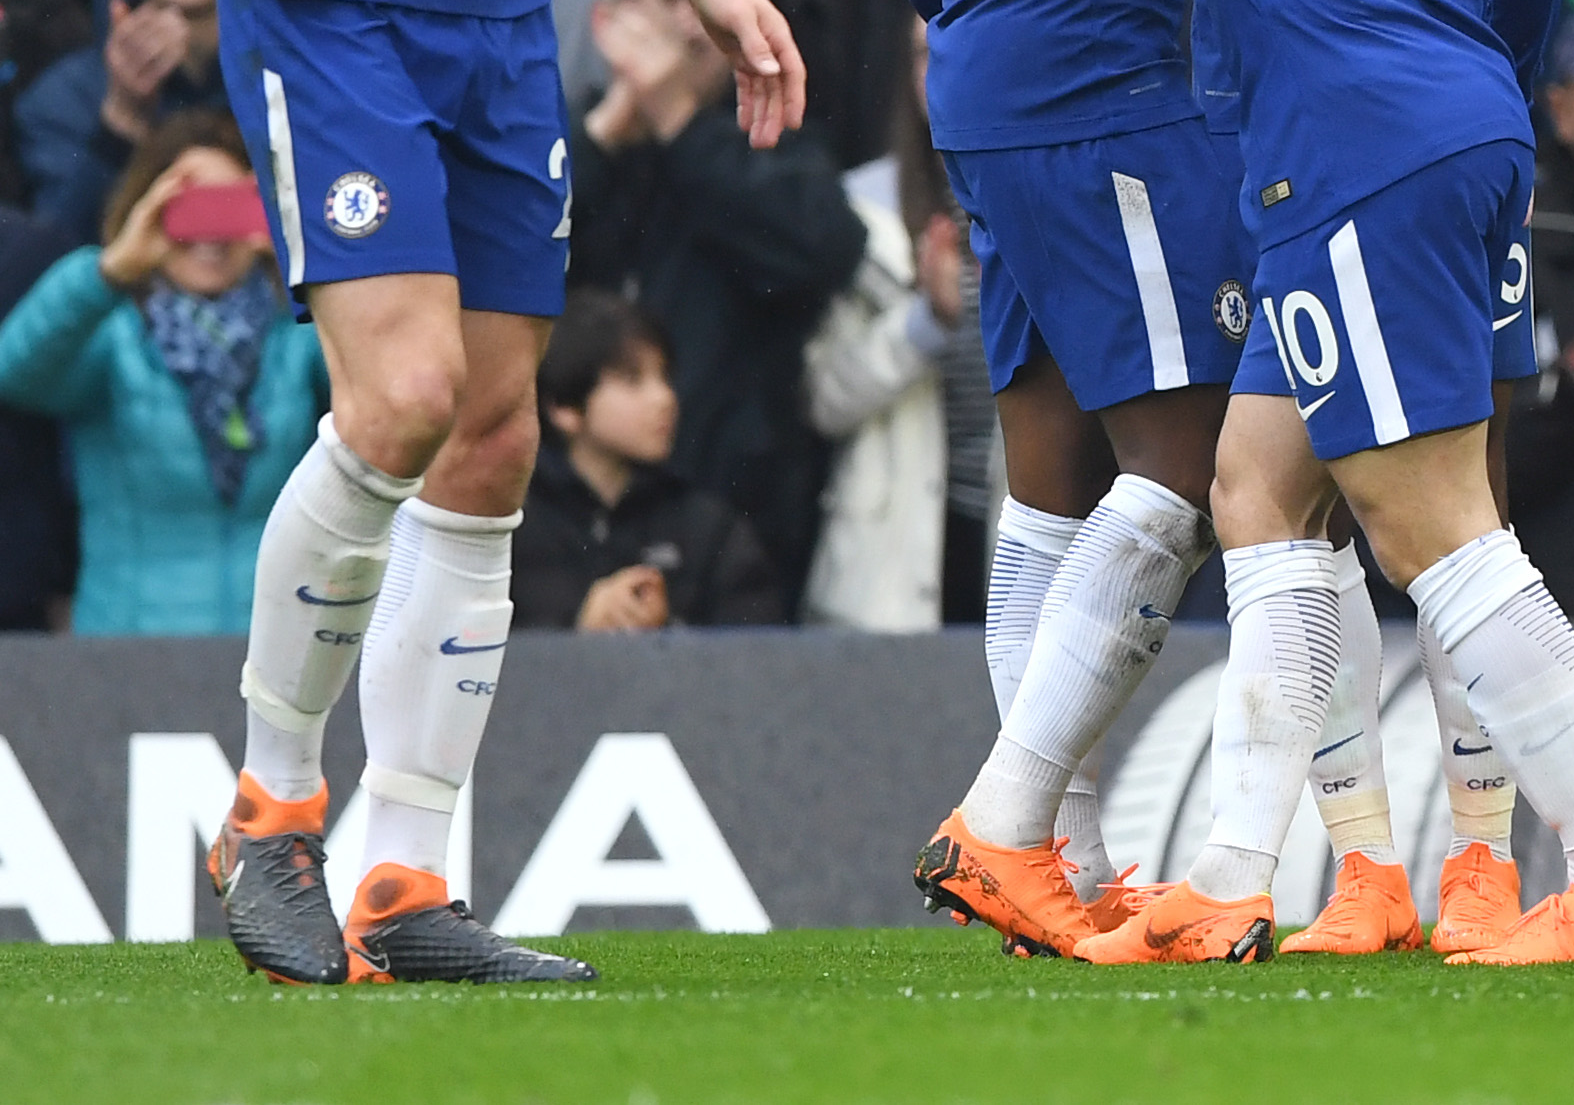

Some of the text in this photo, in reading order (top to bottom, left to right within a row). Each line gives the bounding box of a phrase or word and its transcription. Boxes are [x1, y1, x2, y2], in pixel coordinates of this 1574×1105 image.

[1261, 290, 1339, 387] 10
[314, 629, 362, 646] CFC
[457, 679, 496, 695] CFC
[1322, 777, 1357, 794] CFC
[1467, 777, 1505, 791] CFC
